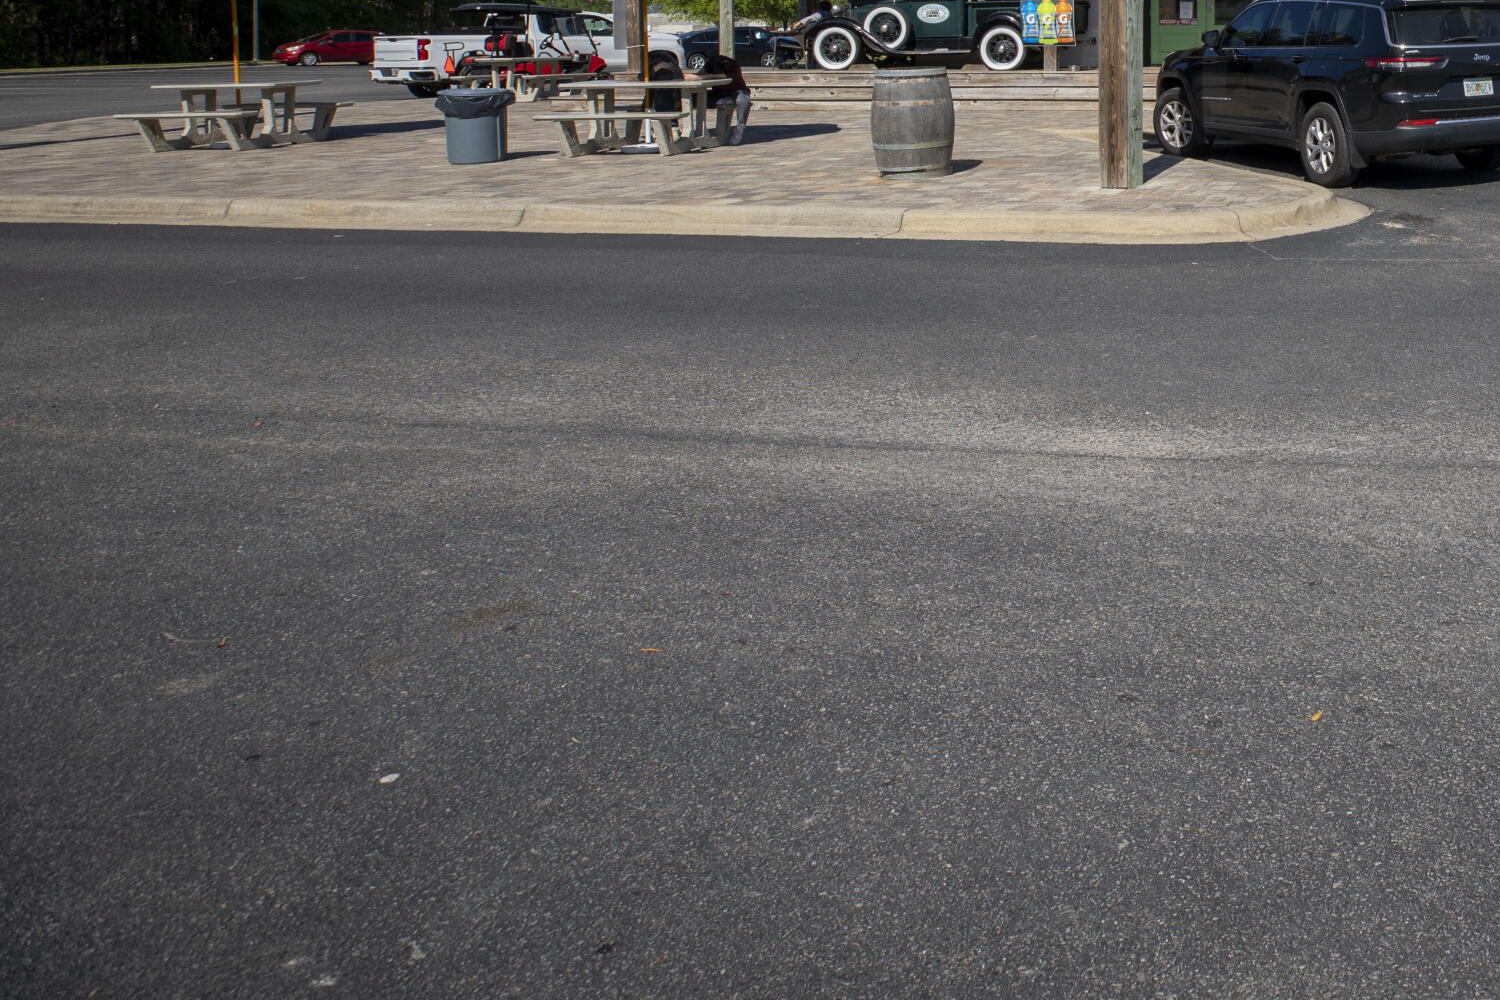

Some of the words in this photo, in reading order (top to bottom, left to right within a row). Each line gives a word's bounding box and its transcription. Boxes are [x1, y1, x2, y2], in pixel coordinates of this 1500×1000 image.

[1026, 13, 1036, 24] G
[1042, 14, 1052, 24] G
[1058, 13, 1068, 24] G
[1473, 53, 1490, 62] Jeep
